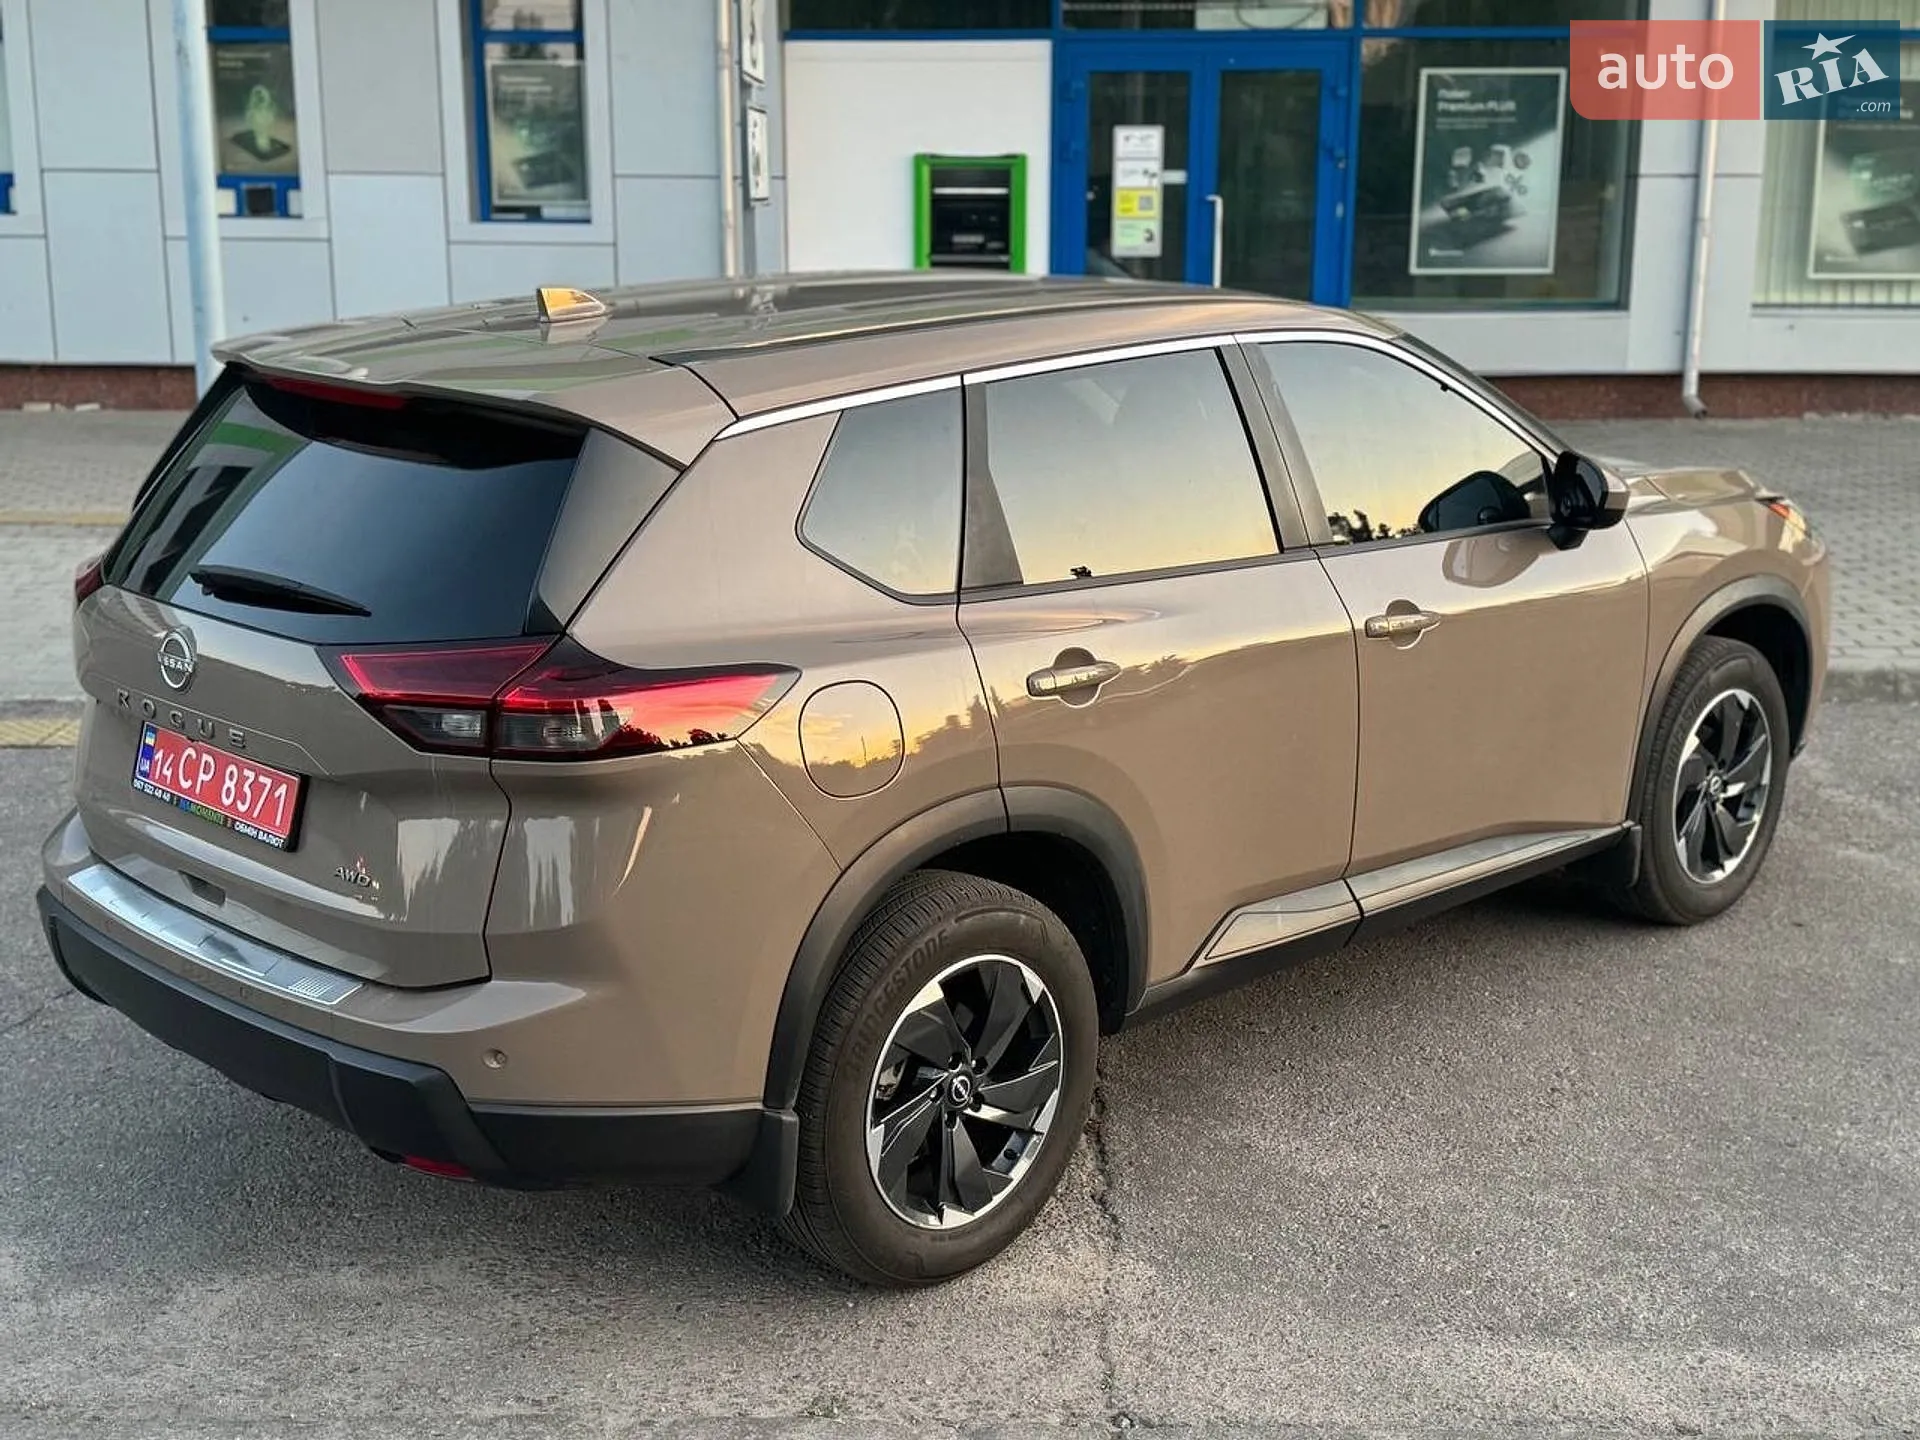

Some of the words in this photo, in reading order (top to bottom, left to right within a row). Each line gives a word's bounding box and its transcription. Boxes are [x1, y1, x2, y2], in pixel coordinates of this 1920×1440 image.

[117, 688, 246, 749] ROGUE
[139, 758, 151, 774] UA
[221, 764, 288, 827] 8371
[334, 866, 371, 887] AWD
